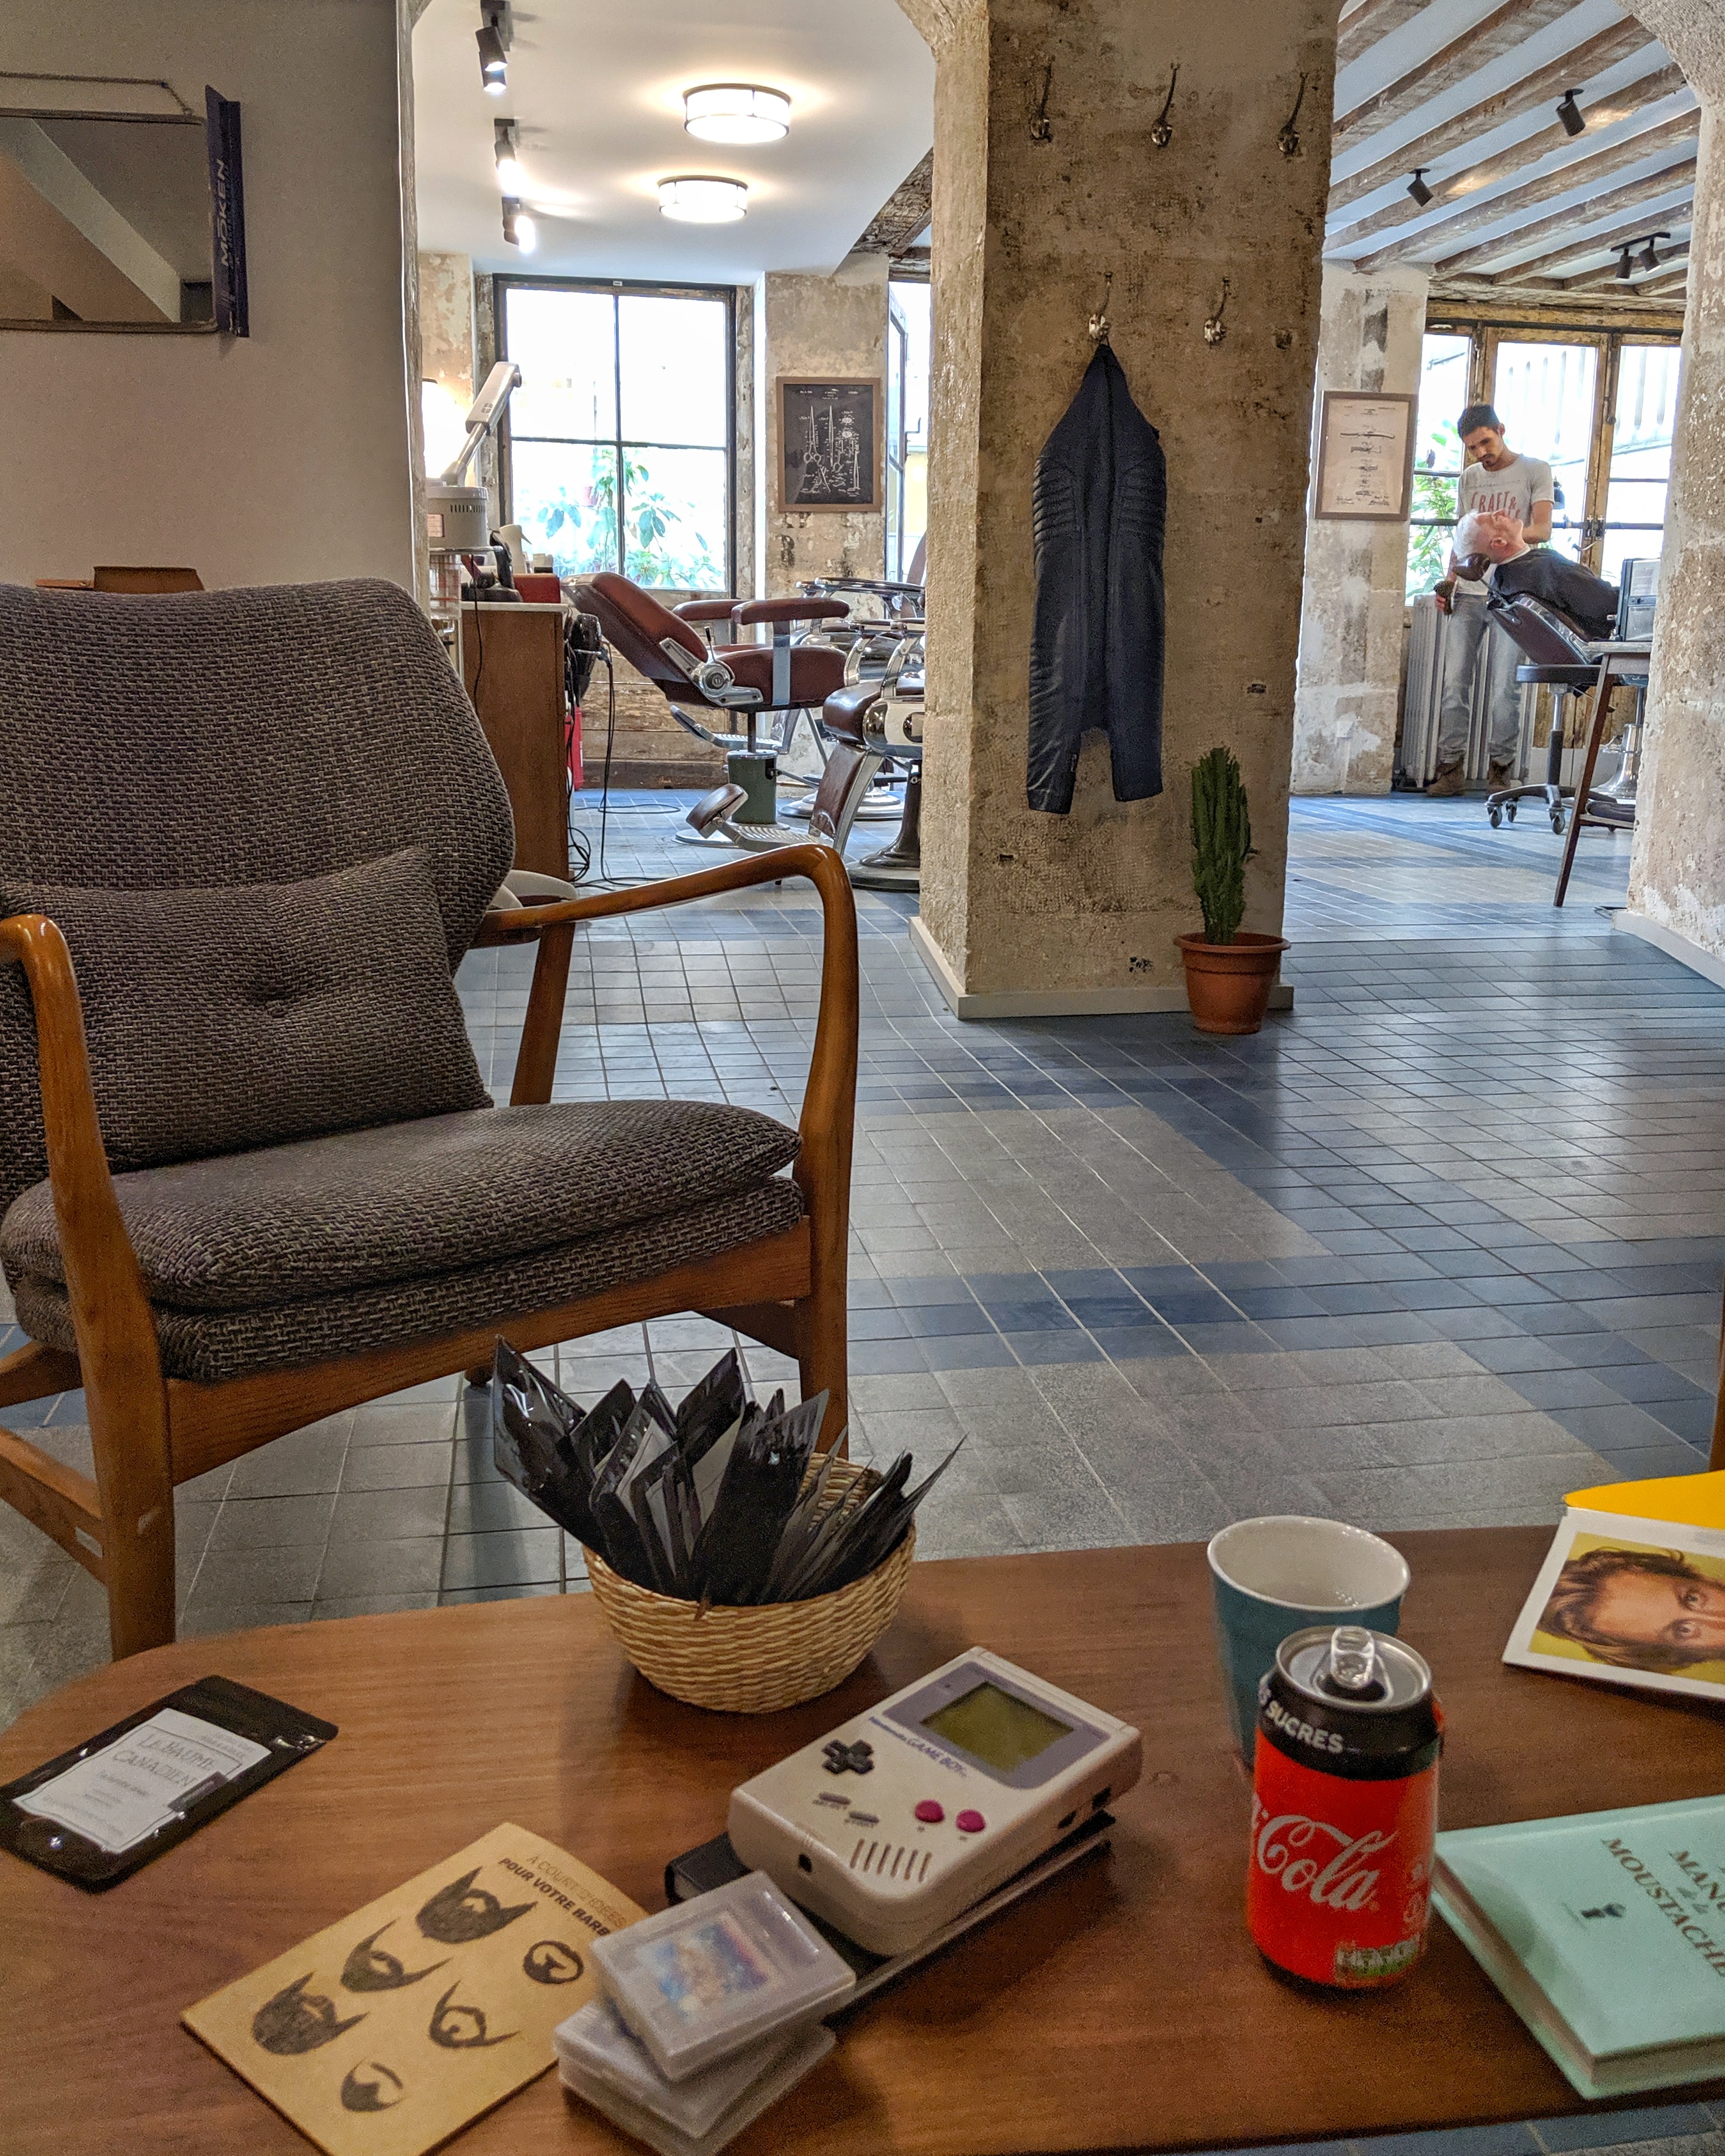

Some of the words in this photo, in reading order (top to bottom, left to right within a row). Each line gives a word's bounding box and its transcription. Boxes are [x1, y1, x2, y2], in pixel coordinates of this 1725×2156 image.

[907, 1737, 941, 1761] GAME
[1265, 1700, 1343, 1754] SUCRES
[113, 1750, 197, 1787] CANADIEN
[1258, 1814, 1400, 1911] Cola
[1668, 1850, 1725, 1916] MAN
[498, 1857, 535, 1882] POUR
[533, 1876, 576, 1911] VOTRE
[572, 1907, 611, 1936] BARB
